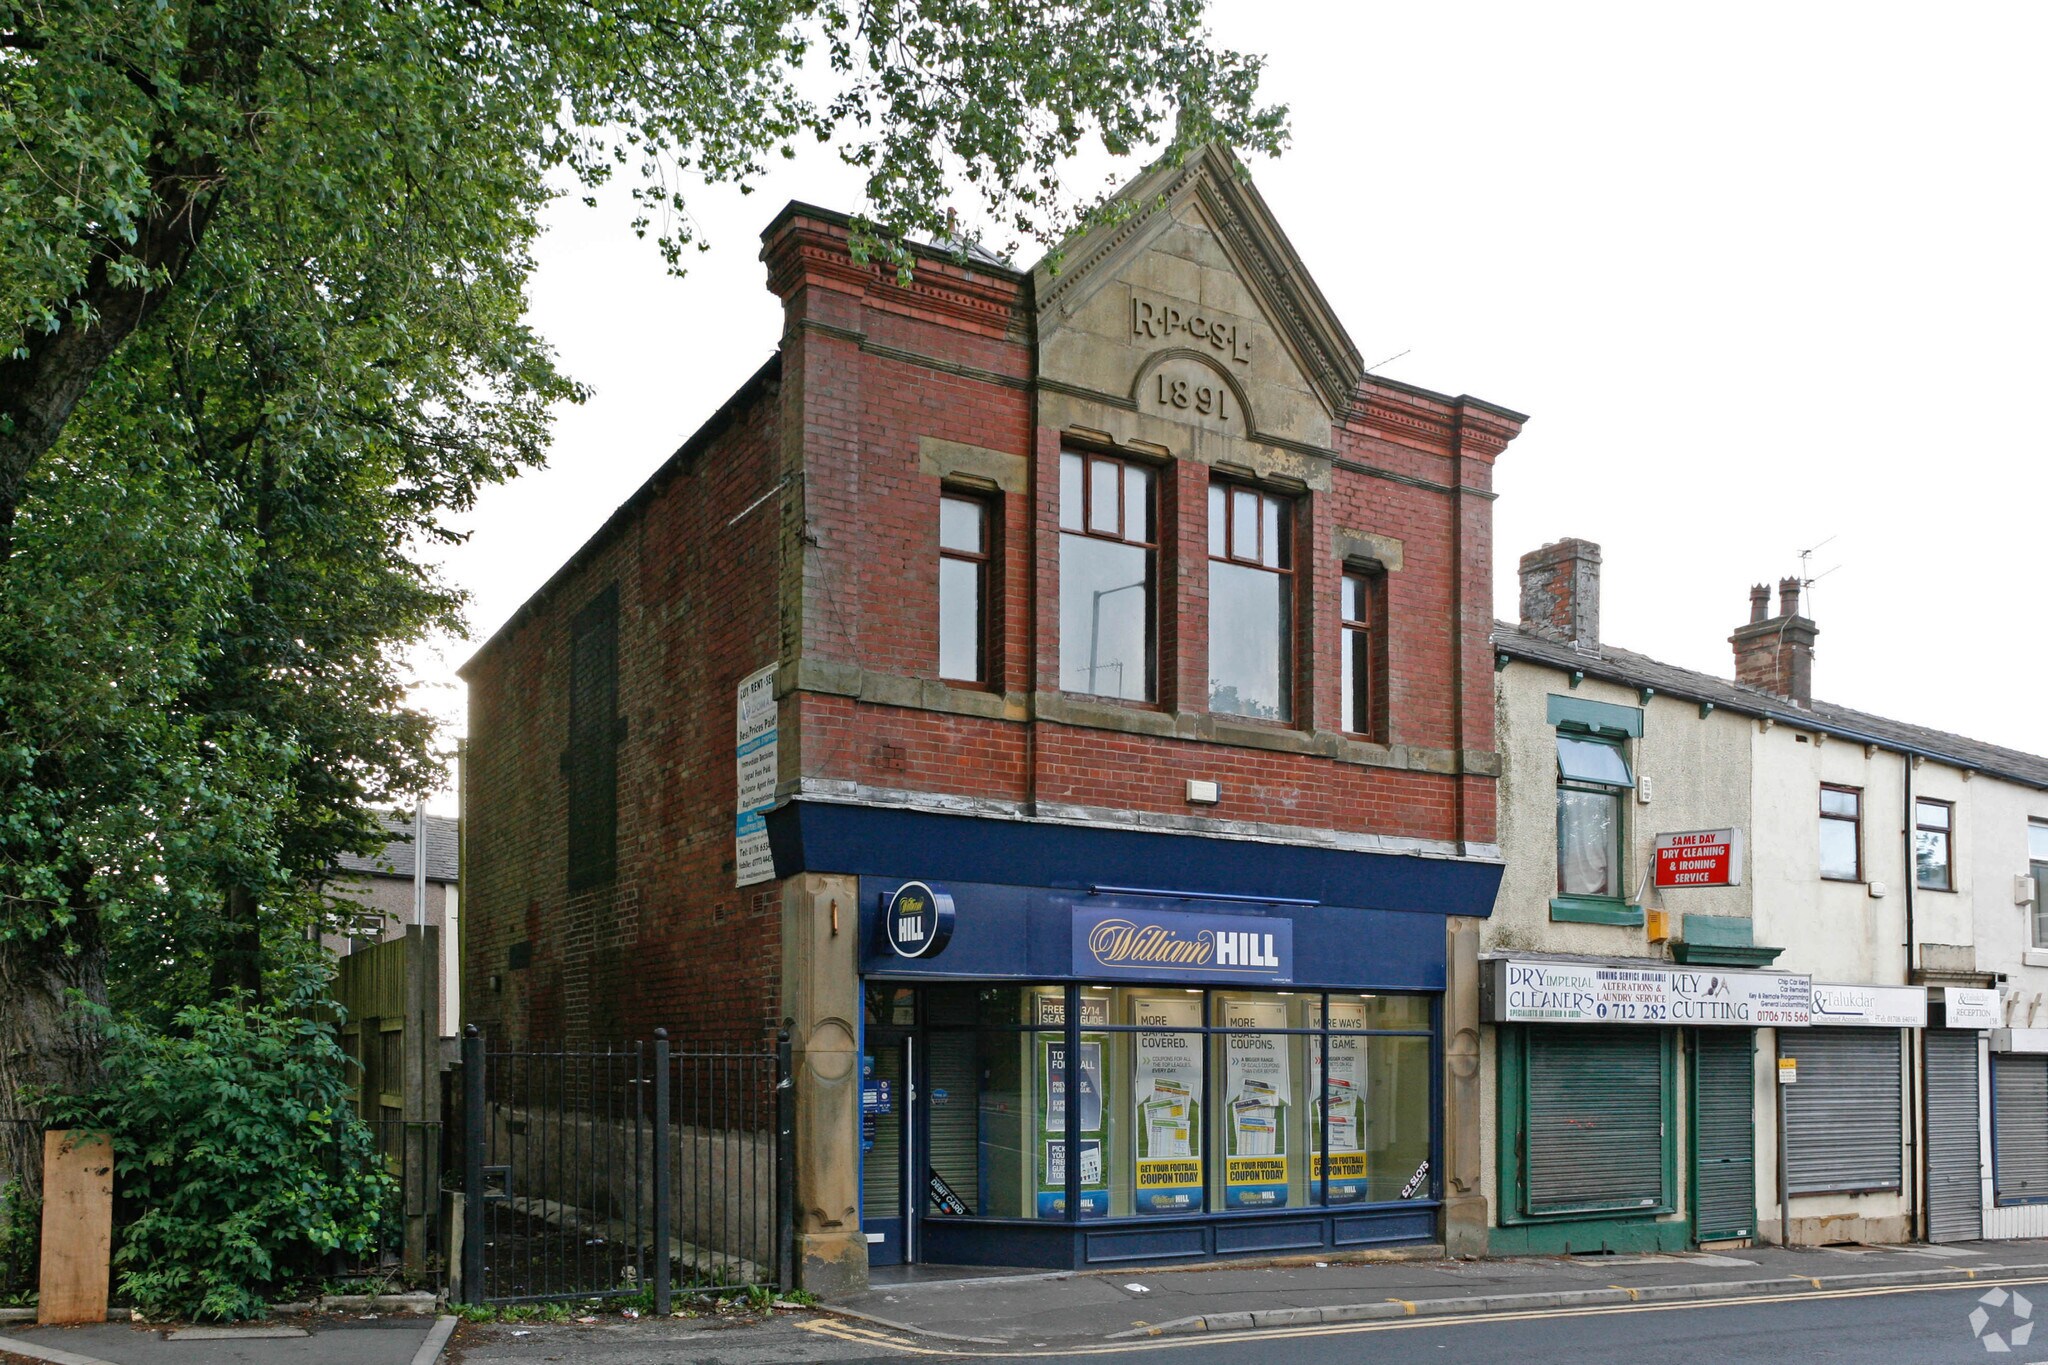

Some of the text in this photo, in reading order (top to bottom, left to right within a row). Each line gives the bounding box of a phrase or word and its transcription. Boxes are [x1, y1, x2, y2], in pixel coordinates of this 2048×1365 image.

[1158, 373, 1229, 420] 1891
[1672, 834, 1716, 846] SAME DAY
[1662, 846, 1725, 859] DRY CLEANING
[1669, 859, 1716, 871] & IRONING
[1675, 872, 1709, 883] SERVICE
[899, 916, 924, 942] HILL
[1089, 918, 1279, 967] William HILL
[1510, 967, 1547, 993] DRY
[1596, 971, 1666, 982] IRONING SERVICE AVAILABLE
[1778, 978, 1788, 986] Chip
[1546, 976, 1594, 991] IMPERIAL
[1601, 982, 1662, 992] ALTERATIONS &
[1672, 974, 1701, 1000] KEY
[1509, 991, 1595, 1015] CLEANERS
[1596, 993, 1667, 1003] LAUNDRY SERVICE
[1825, 992, 1876, 1007] Talukdar
[1042, 1005, 1065, 1014] FREE
[1509, 1009, 1538, 1017] SPECIALISTS
[1612, 1004, 1666, 1019] 712 282
[1672, 1001, 1749, 1020] CUTTING
[1956, 1008, 1991, 1017] RECEPTION
[1042, 1014, 1065, 1024] SEAS
[1141, 1015, 1167, 1026] MORE
[1230, 1017, 1256, 1027] MORE
[1757, 1011, 1808, 1022] 01706 715 566
[1313, 1018, 1362, 1028] MRE WAYS
[1142, 1038, 1188, 1048] COVERED.
[1230, 1039, 1275, 1049] COUPONS.
[1331, 1040, 1358, 1049] GAME.
[1230, 1161, 1284, 1170] GET YOUR FOOTBALL
[1339, 1156, 1364, 1164] FOOTBALL
[1141, 1163, 1198, 1173] GET YOUR FOOTBALL
[1314, 1165, 1364, 1176] CPON TODAY
[1140, 1172, 1198, 1184] COUPON TODAY
[1230, 1169, 1284, 1181] COUPON TODAY
[1402, 1184, 1412, 1199] £2
[1410, 1160, 1429, 1187] SLOTS
[930, 1178, 948, 1197] DEBIT
[946, 1195, 964, 1215] CARD
[930, 1191, 942, 1203] VISA
[1175, 1194, 1189, 1203] HILL
[1262, 1191, 1275, 1199] HILL
